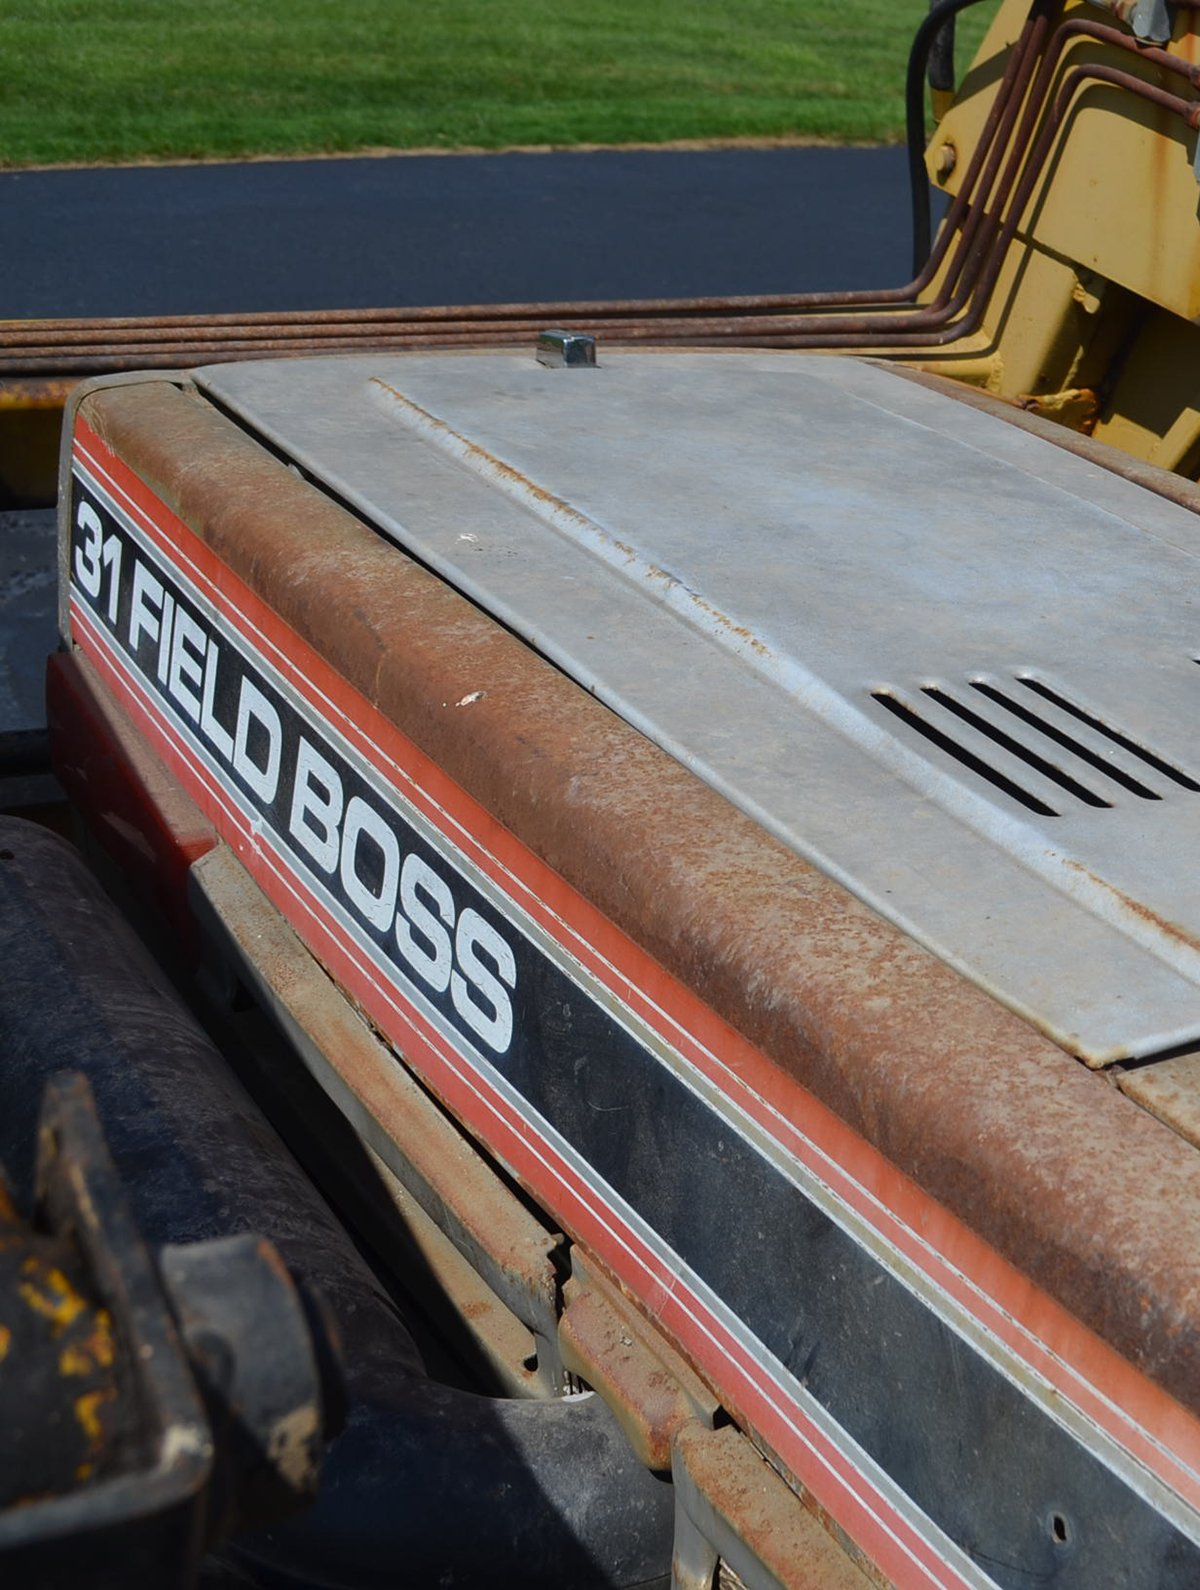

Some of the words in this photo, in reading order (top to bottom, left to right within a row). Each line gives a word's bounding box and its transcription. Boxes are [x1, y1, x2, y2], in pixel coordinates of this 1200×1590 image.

[75, 501, 122, 625] 31
[129, 559, 282, 804] FIELD
[288, 736, 517, 1053] BOSS
